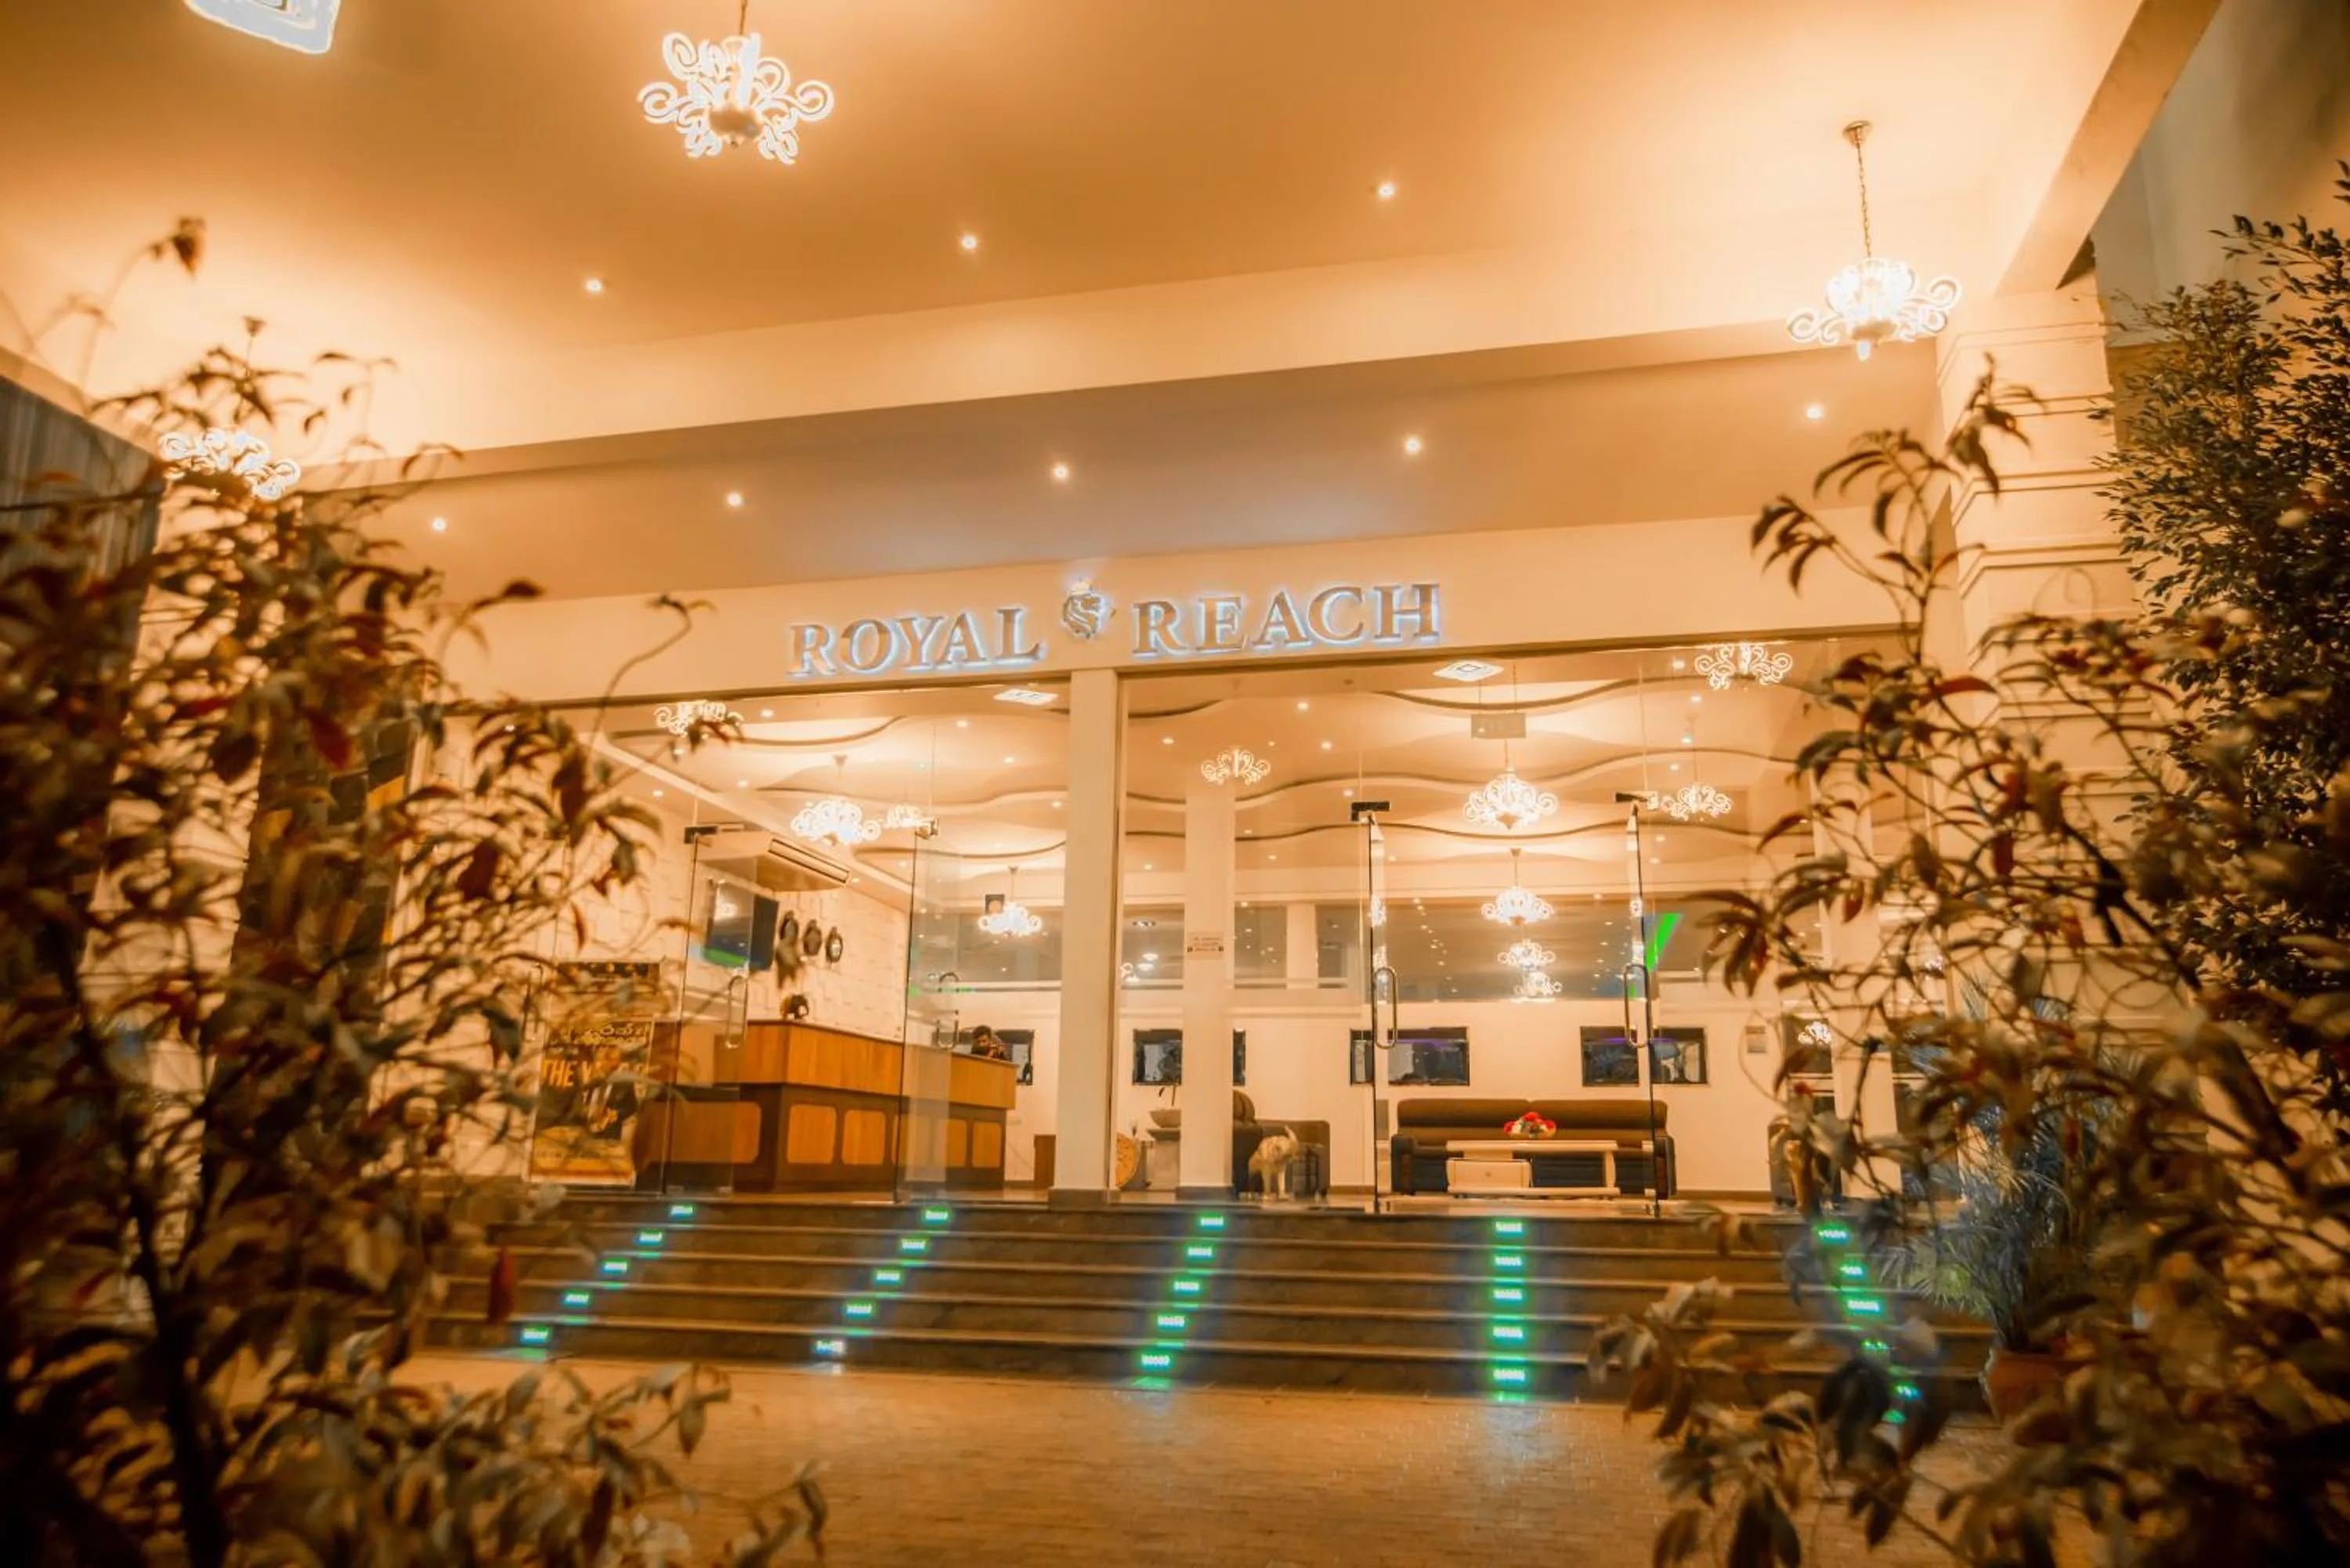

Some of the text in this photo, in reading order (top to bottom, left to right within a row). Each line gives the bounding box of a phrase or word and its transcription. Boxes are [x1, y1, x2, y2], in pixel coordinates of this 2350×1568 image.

[787, 583, 1441, 677] ROYAL REACH
[542, 1058, 578, 1088] THE
